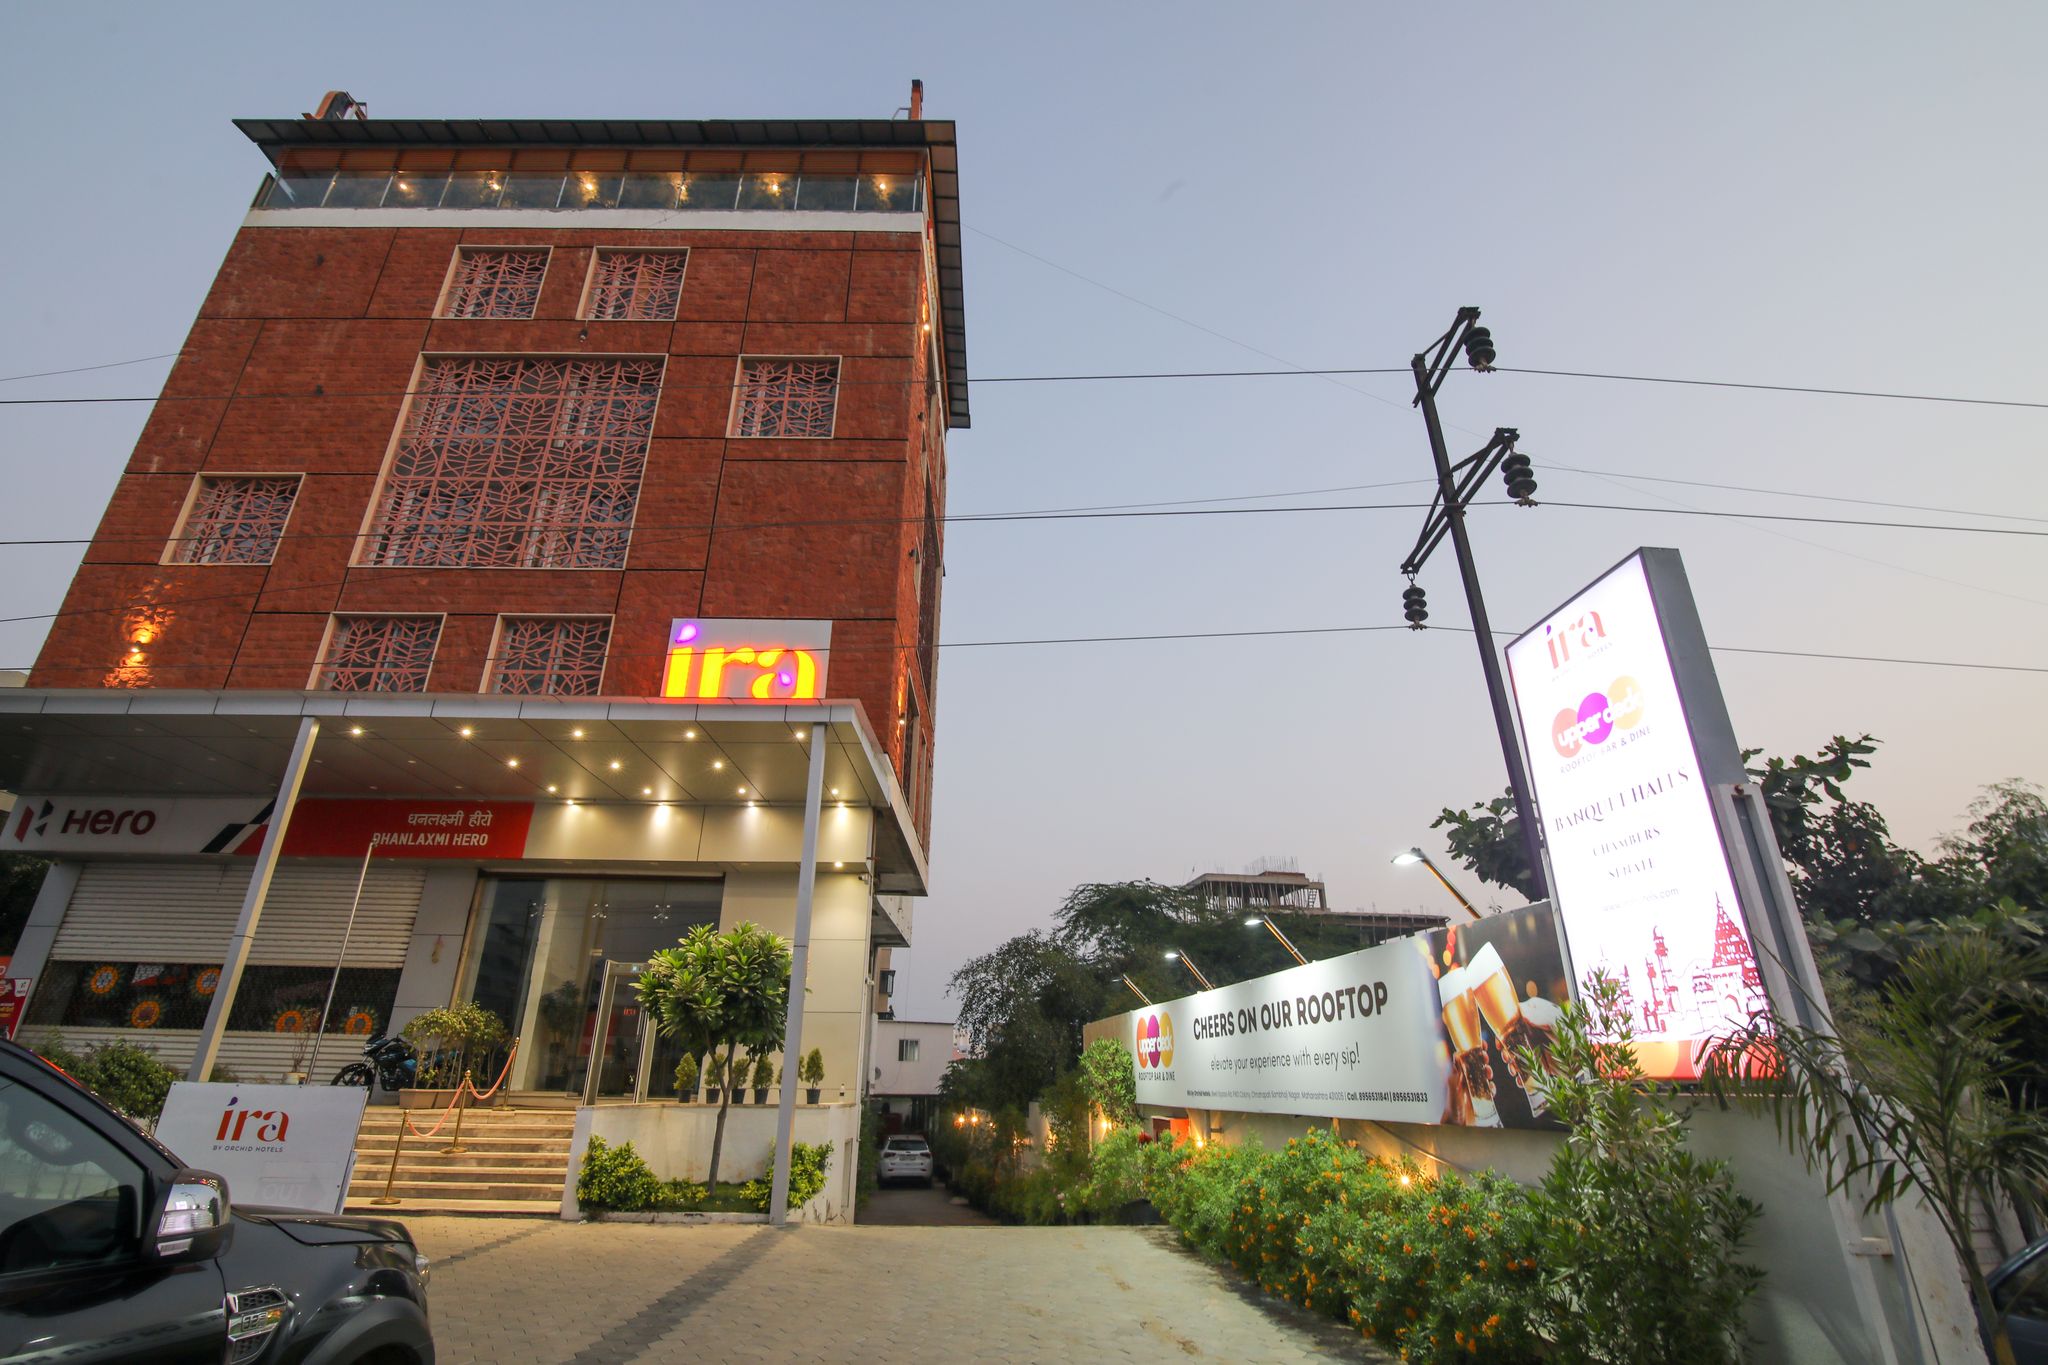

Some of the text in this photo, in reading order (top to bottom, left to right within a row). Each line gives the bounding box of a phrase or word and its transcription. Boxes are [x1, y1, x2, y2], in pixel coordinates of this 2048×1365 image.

[1545, 611, 1607, 669] ira
[665, 623, 816, 699] ira
[1556, 710, 1602, 750] upper
[1620, 737, 1627, 746] &
[61, 809, 156, 836] Hero
[408, 810, 493, 828] धनलक्ष्मी हीरो
[372, 833, 489, 847] DHANLAXMI HERO
[1193, 981, 1388, 1041] CHEERS ON OUR ROOFTOP
[1138, 1025, 1173, 1060] upper deck
[1210, 1042, 1361, 1074] elevate your experience with every sip!
[216, 1096, 289, 1142] ira
